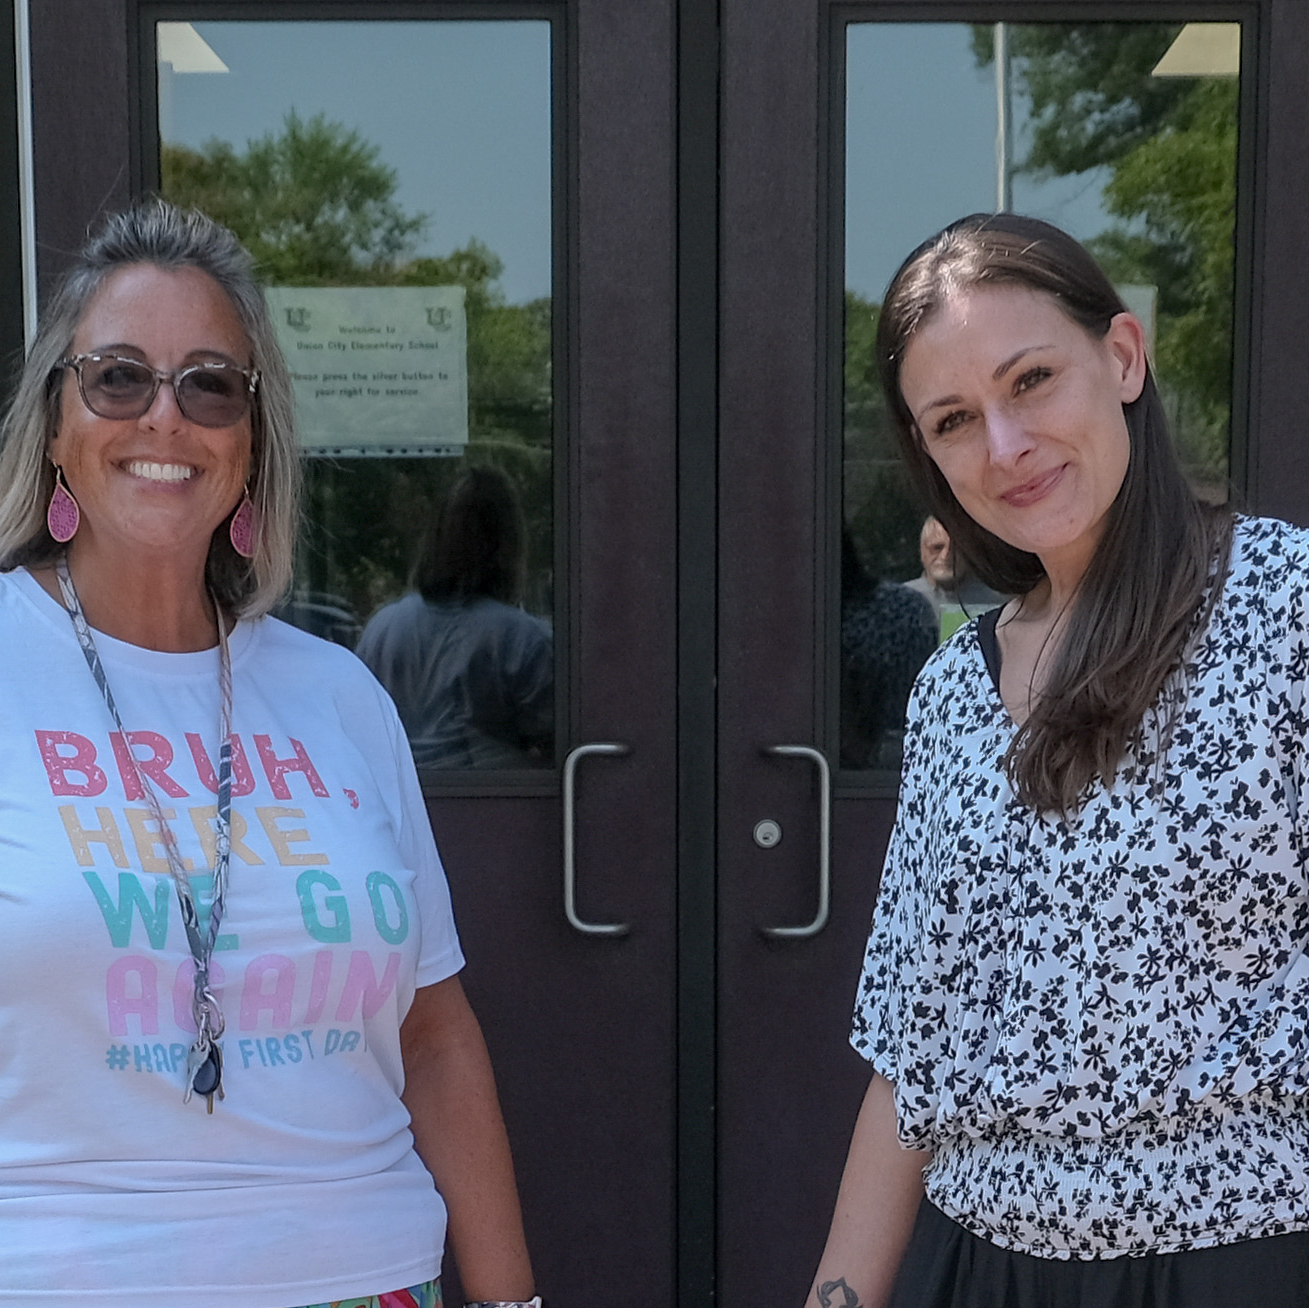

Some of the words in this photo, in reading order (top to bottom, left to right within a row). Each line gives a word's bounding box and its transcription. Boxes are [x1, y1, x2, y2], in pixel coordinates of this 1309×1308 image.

[328, 340, 346, 352] City
[351, 340, 404, 352] Elementary
[408, 340, 439, 350] School
[340, 387, 362, 398] right
[367, 387, 380, 396] for
[352, 371, 368, 381] the
[372, 371, 399, 381] silver
[402, 371, 434, 381] button
[438, 371, 448, 381] to
[34, 729, 360, 810] BRUH,
[57, 805, 331, 873] HERE
[82, 870, 240, 951] WE
[295, 869, 410, 945] GO
[105, 950, 402, 1036] AGAIN
[105, 1040, 224, 1074] #HAP
[239, 1029, 315, 1070] FIRST
[324, 1028, 368, 1057] DA
